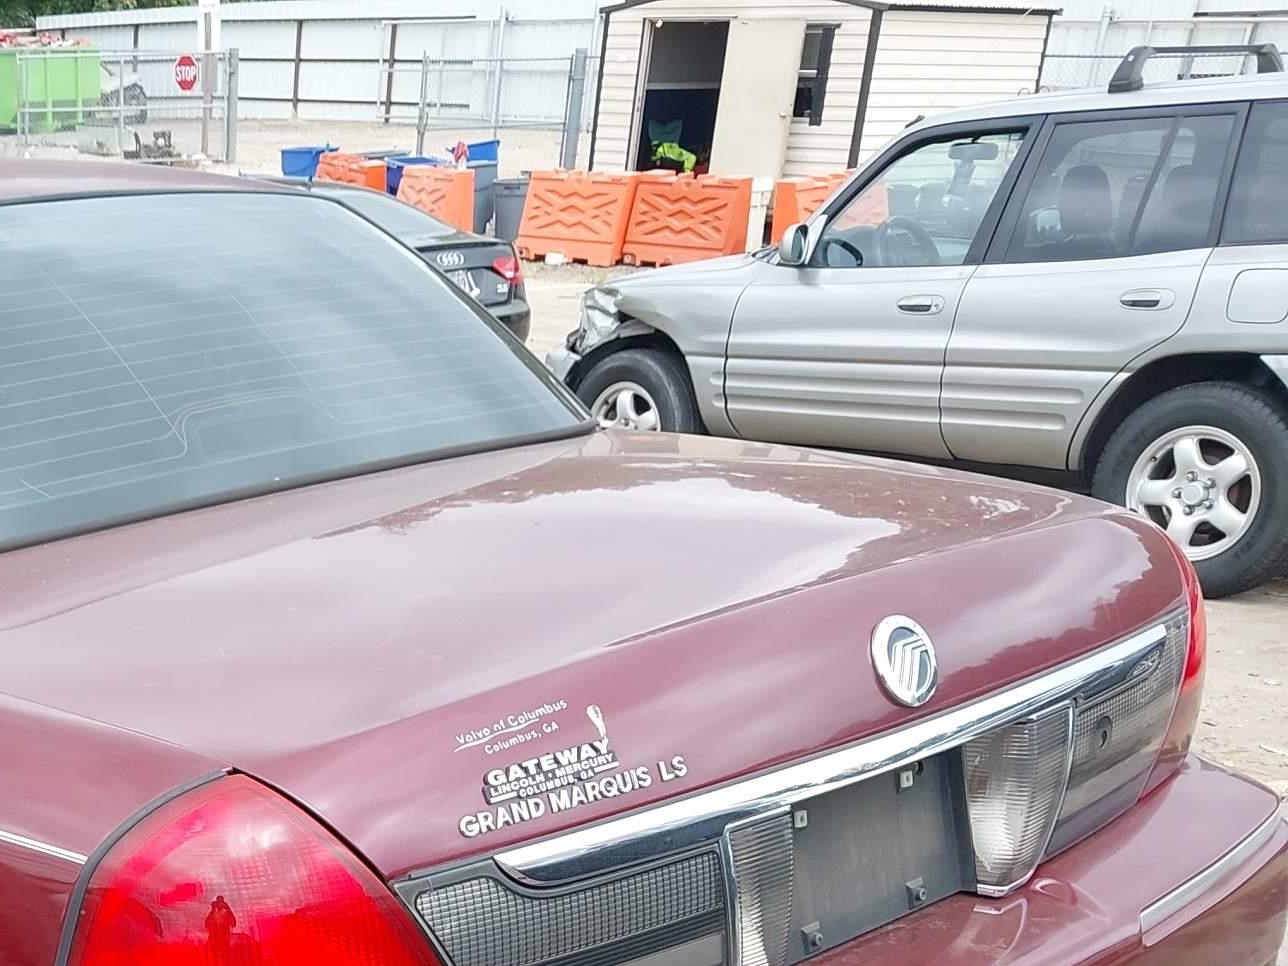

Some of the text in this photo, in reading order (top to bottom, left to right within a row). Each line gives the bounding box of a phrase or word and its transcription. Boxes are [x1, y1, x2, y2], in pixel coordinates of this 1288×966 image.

[176, 65, 197, 81] STOP
[507, 699, 568, 727] Columbus
[484, 721, 559, 754] Columbus, GA
[485, 738, 610, 786] GATEWAY
[490, 752, 614, 797] LINCOLN MERCURY
[580, 769, 595, 780] GA
[459, 755, 689, 837] GRAND MARQUIS LS
